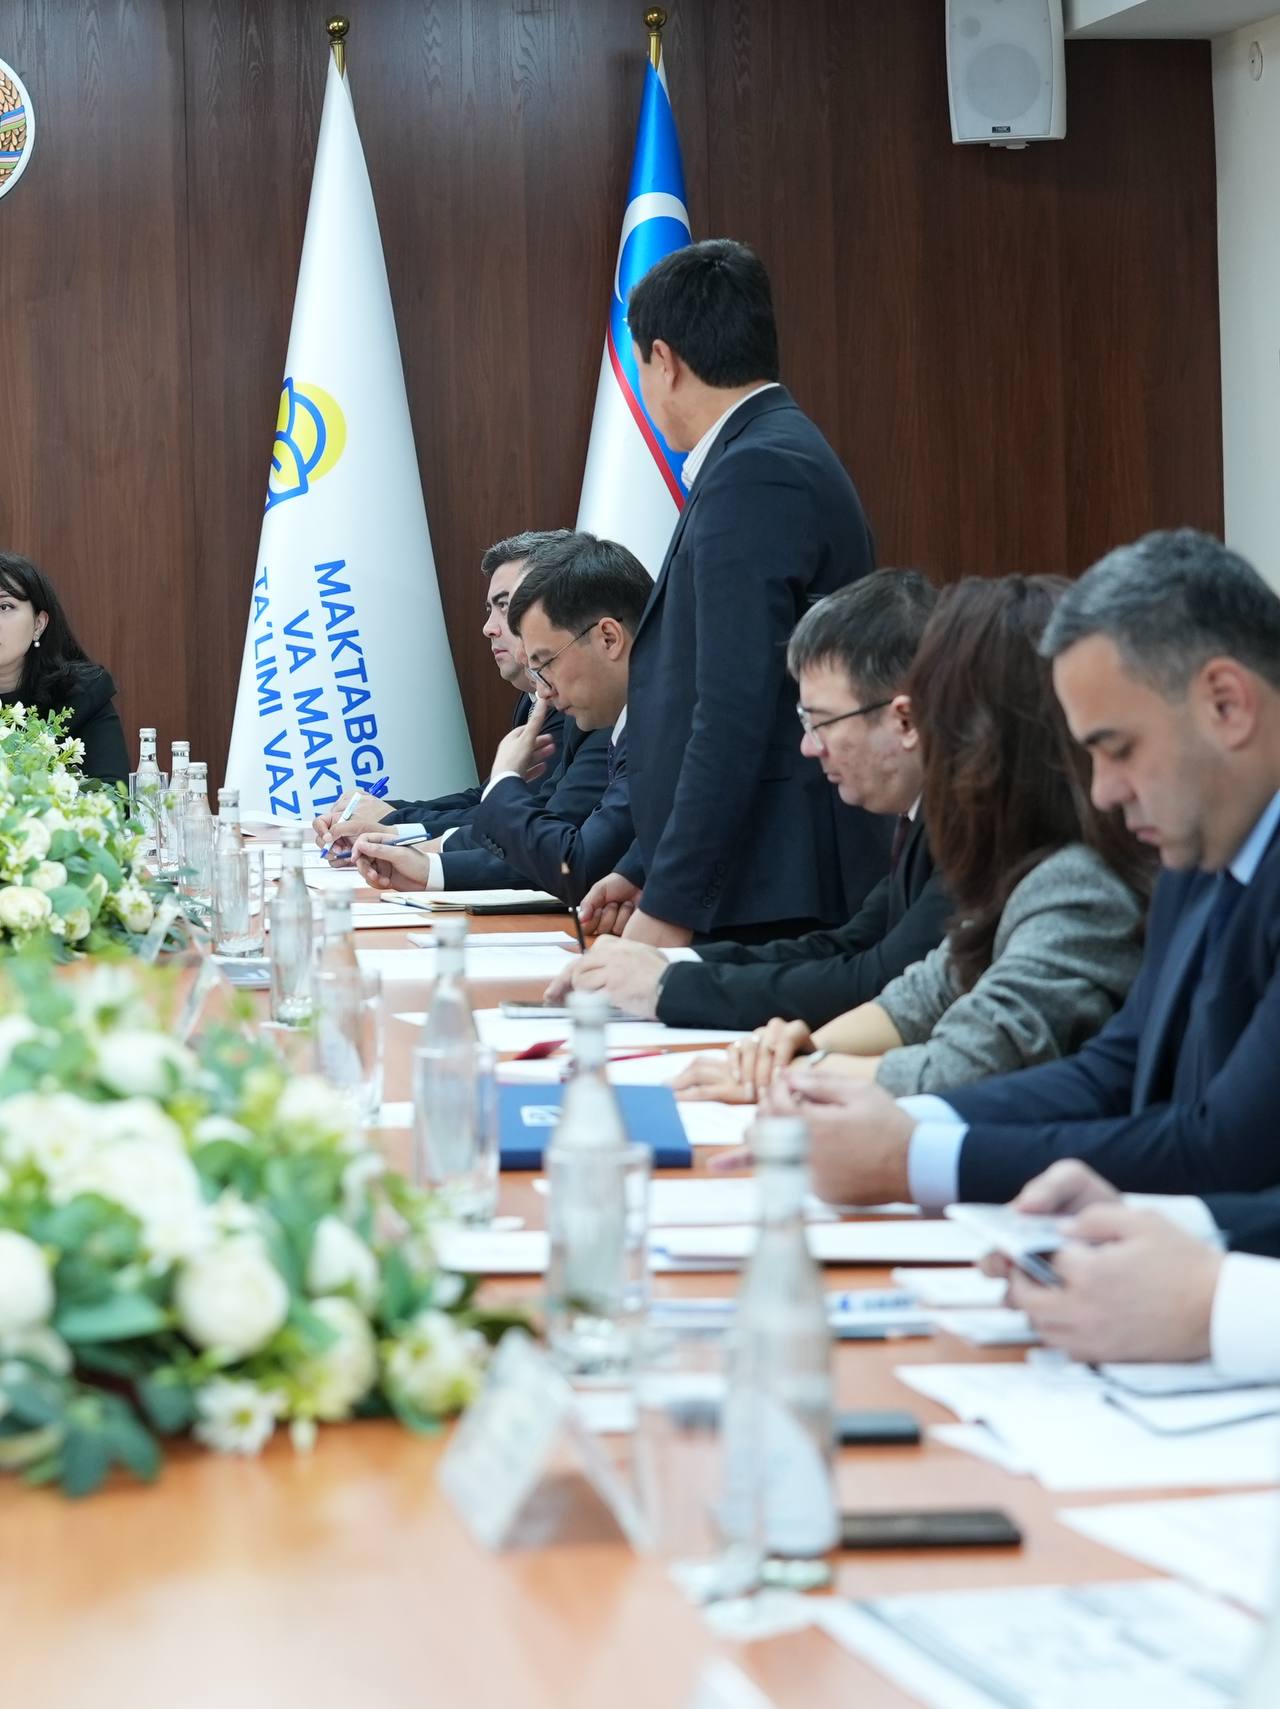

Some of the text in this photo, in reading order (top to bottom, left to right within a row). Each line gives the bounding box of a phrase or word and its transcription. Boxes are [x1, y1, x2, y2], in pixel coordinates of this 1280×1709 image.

[263, 729, 302, 821] VAZ
[283, 609, 343, 818] VA MAKT
